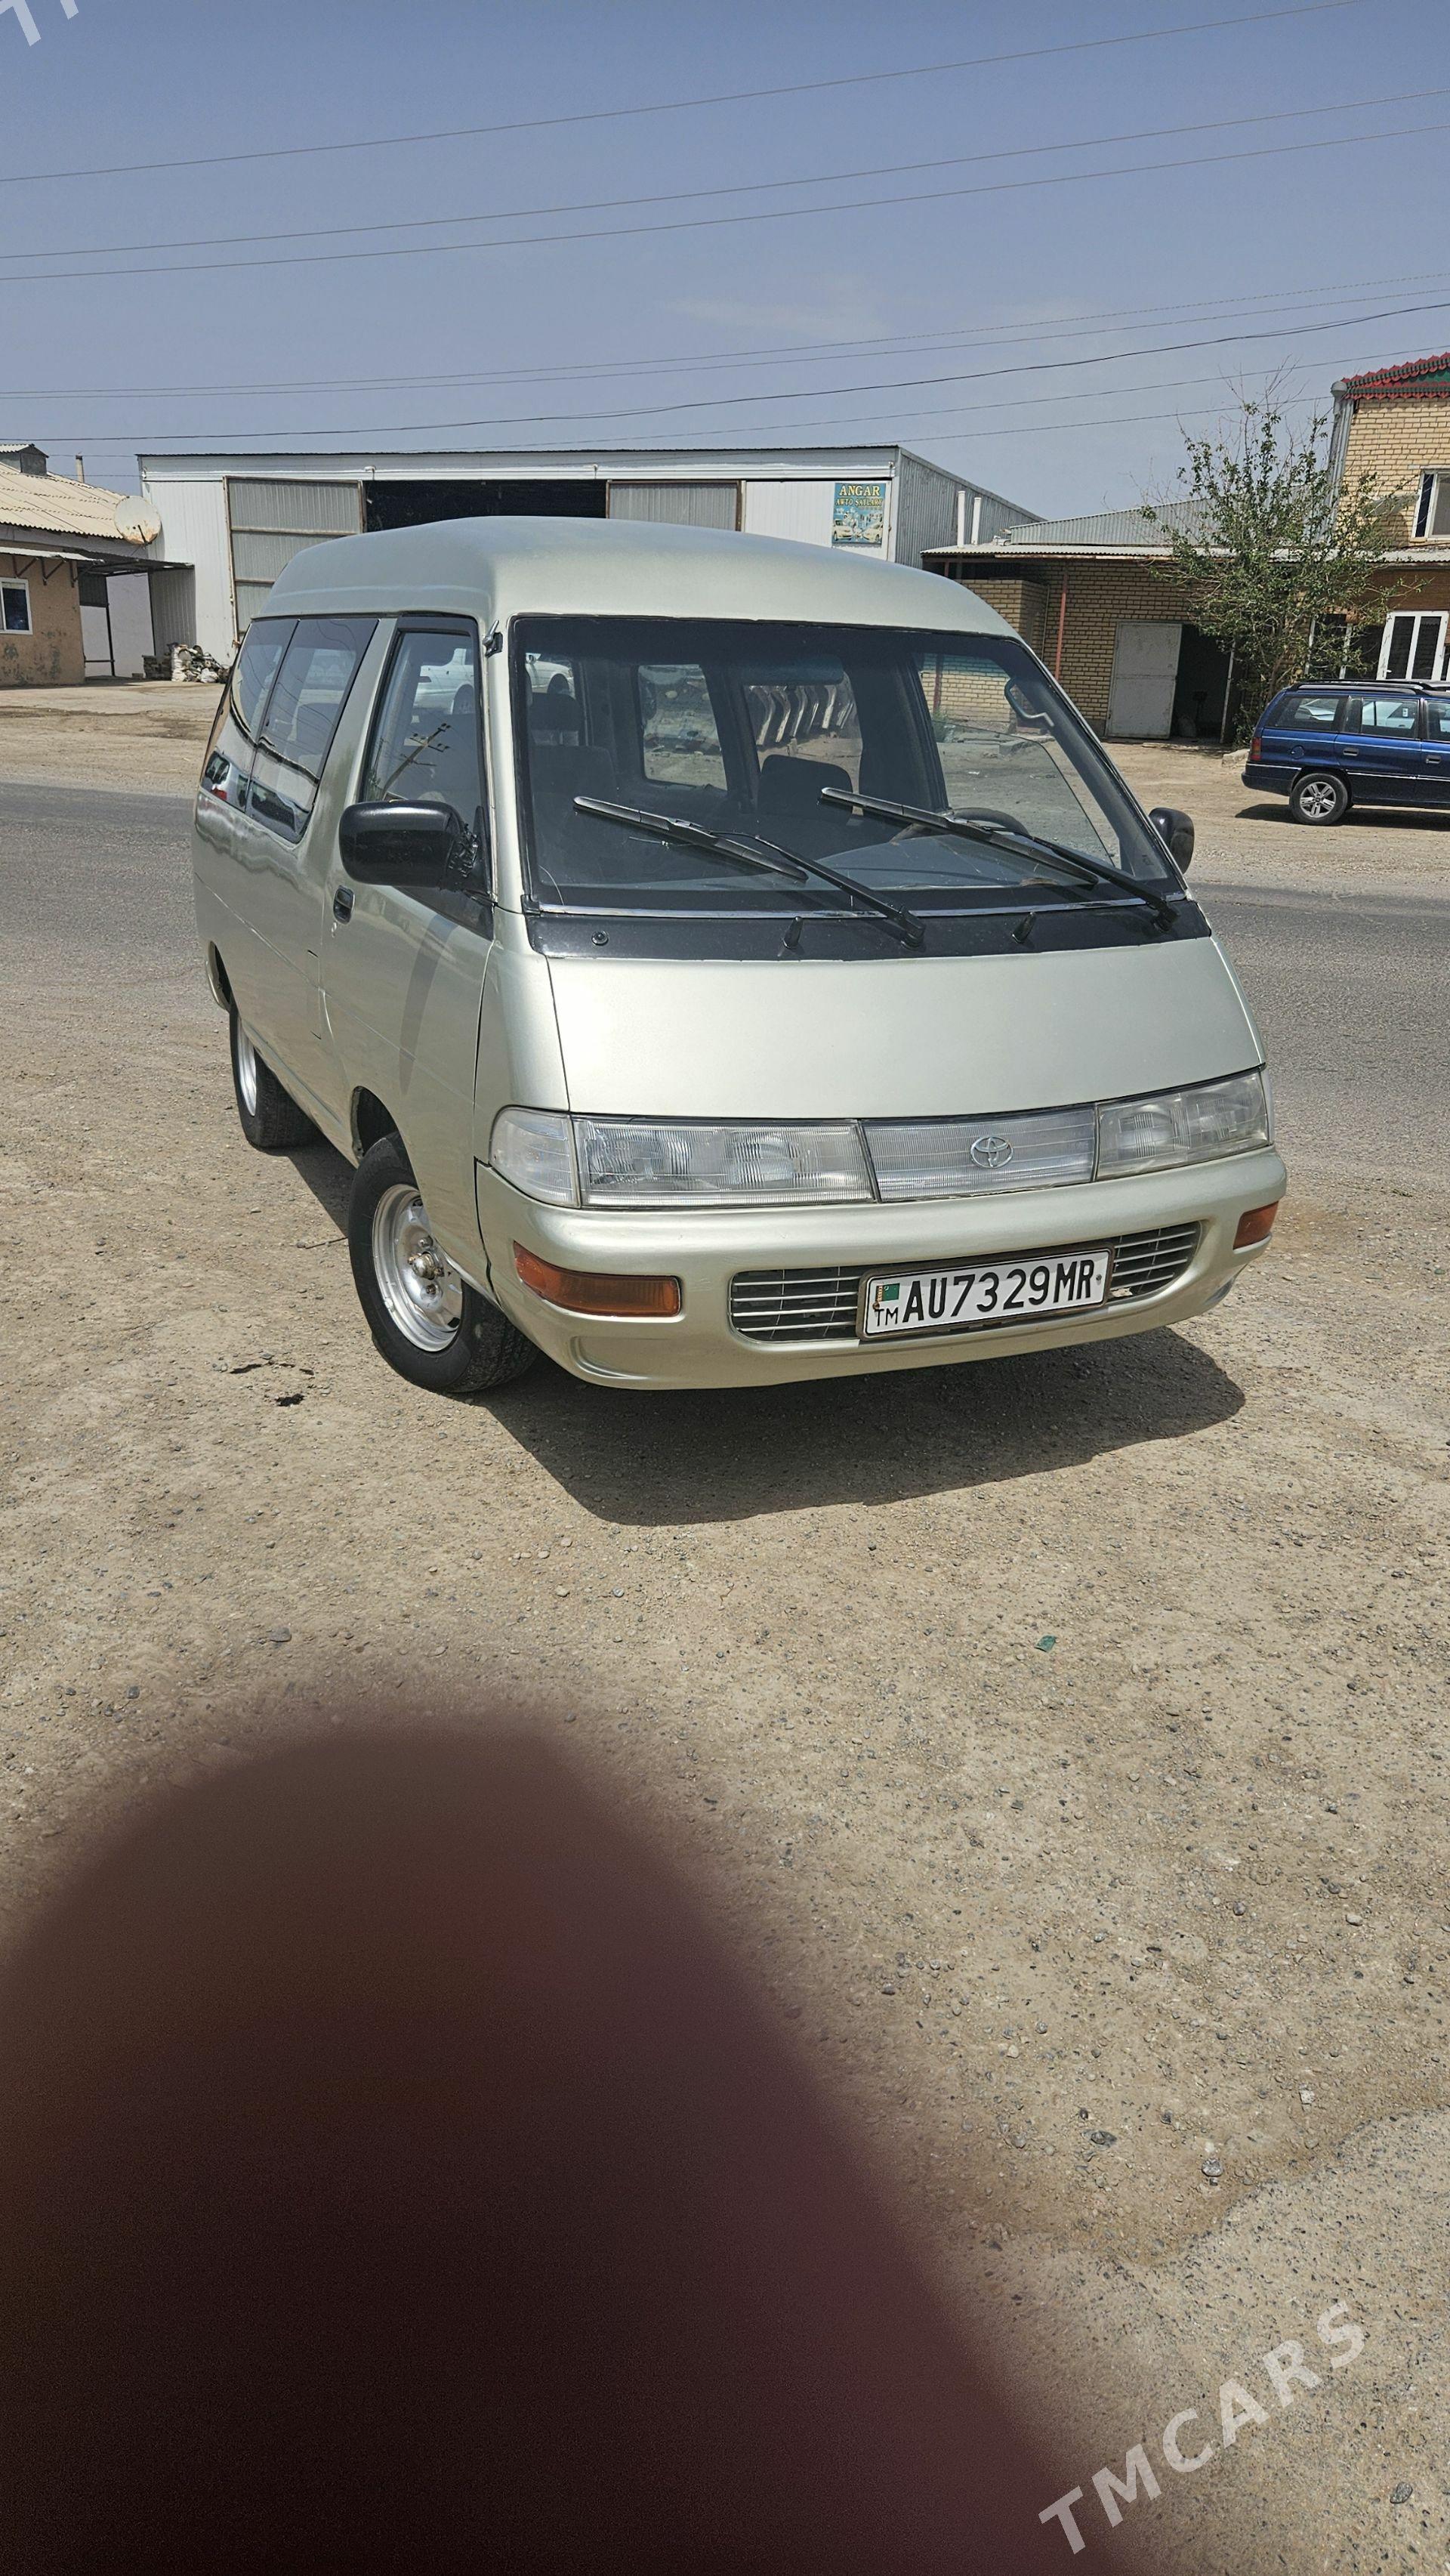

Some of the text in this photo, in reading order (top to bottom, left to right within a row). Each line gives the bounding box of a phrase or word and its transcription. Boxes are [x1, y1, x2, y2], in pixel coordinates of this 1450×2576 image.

[839, 485, 880, 496] ANGAR
[875, 1259, 1095, 1327] TM AU7329MR
